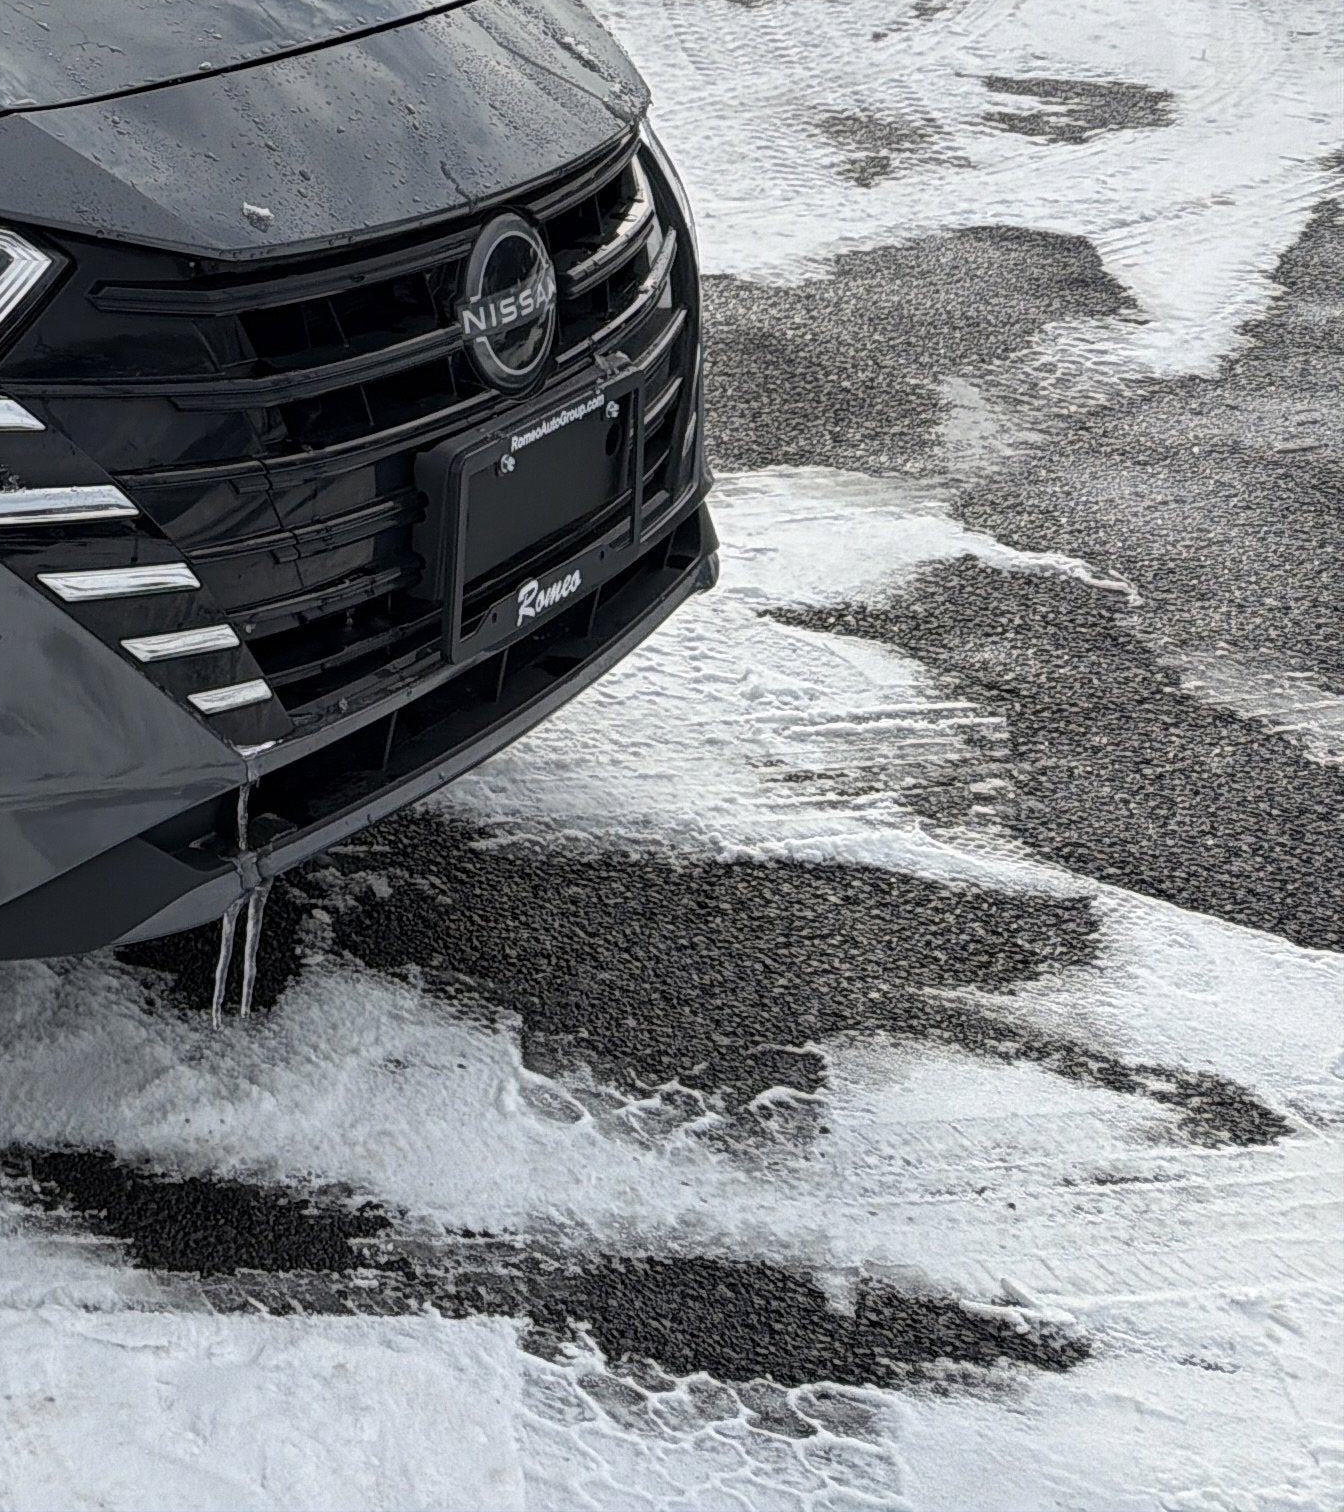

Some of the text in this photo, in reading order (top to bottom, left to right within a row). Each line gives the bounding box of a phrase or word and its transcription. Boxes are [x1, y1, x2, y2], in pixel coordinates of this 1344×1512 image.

[462, 275, 557, 335] NISSAN
[511, 393, 605, 453] RomeoAutoGroup.com
[516, 569, 582, 627] Romeo
